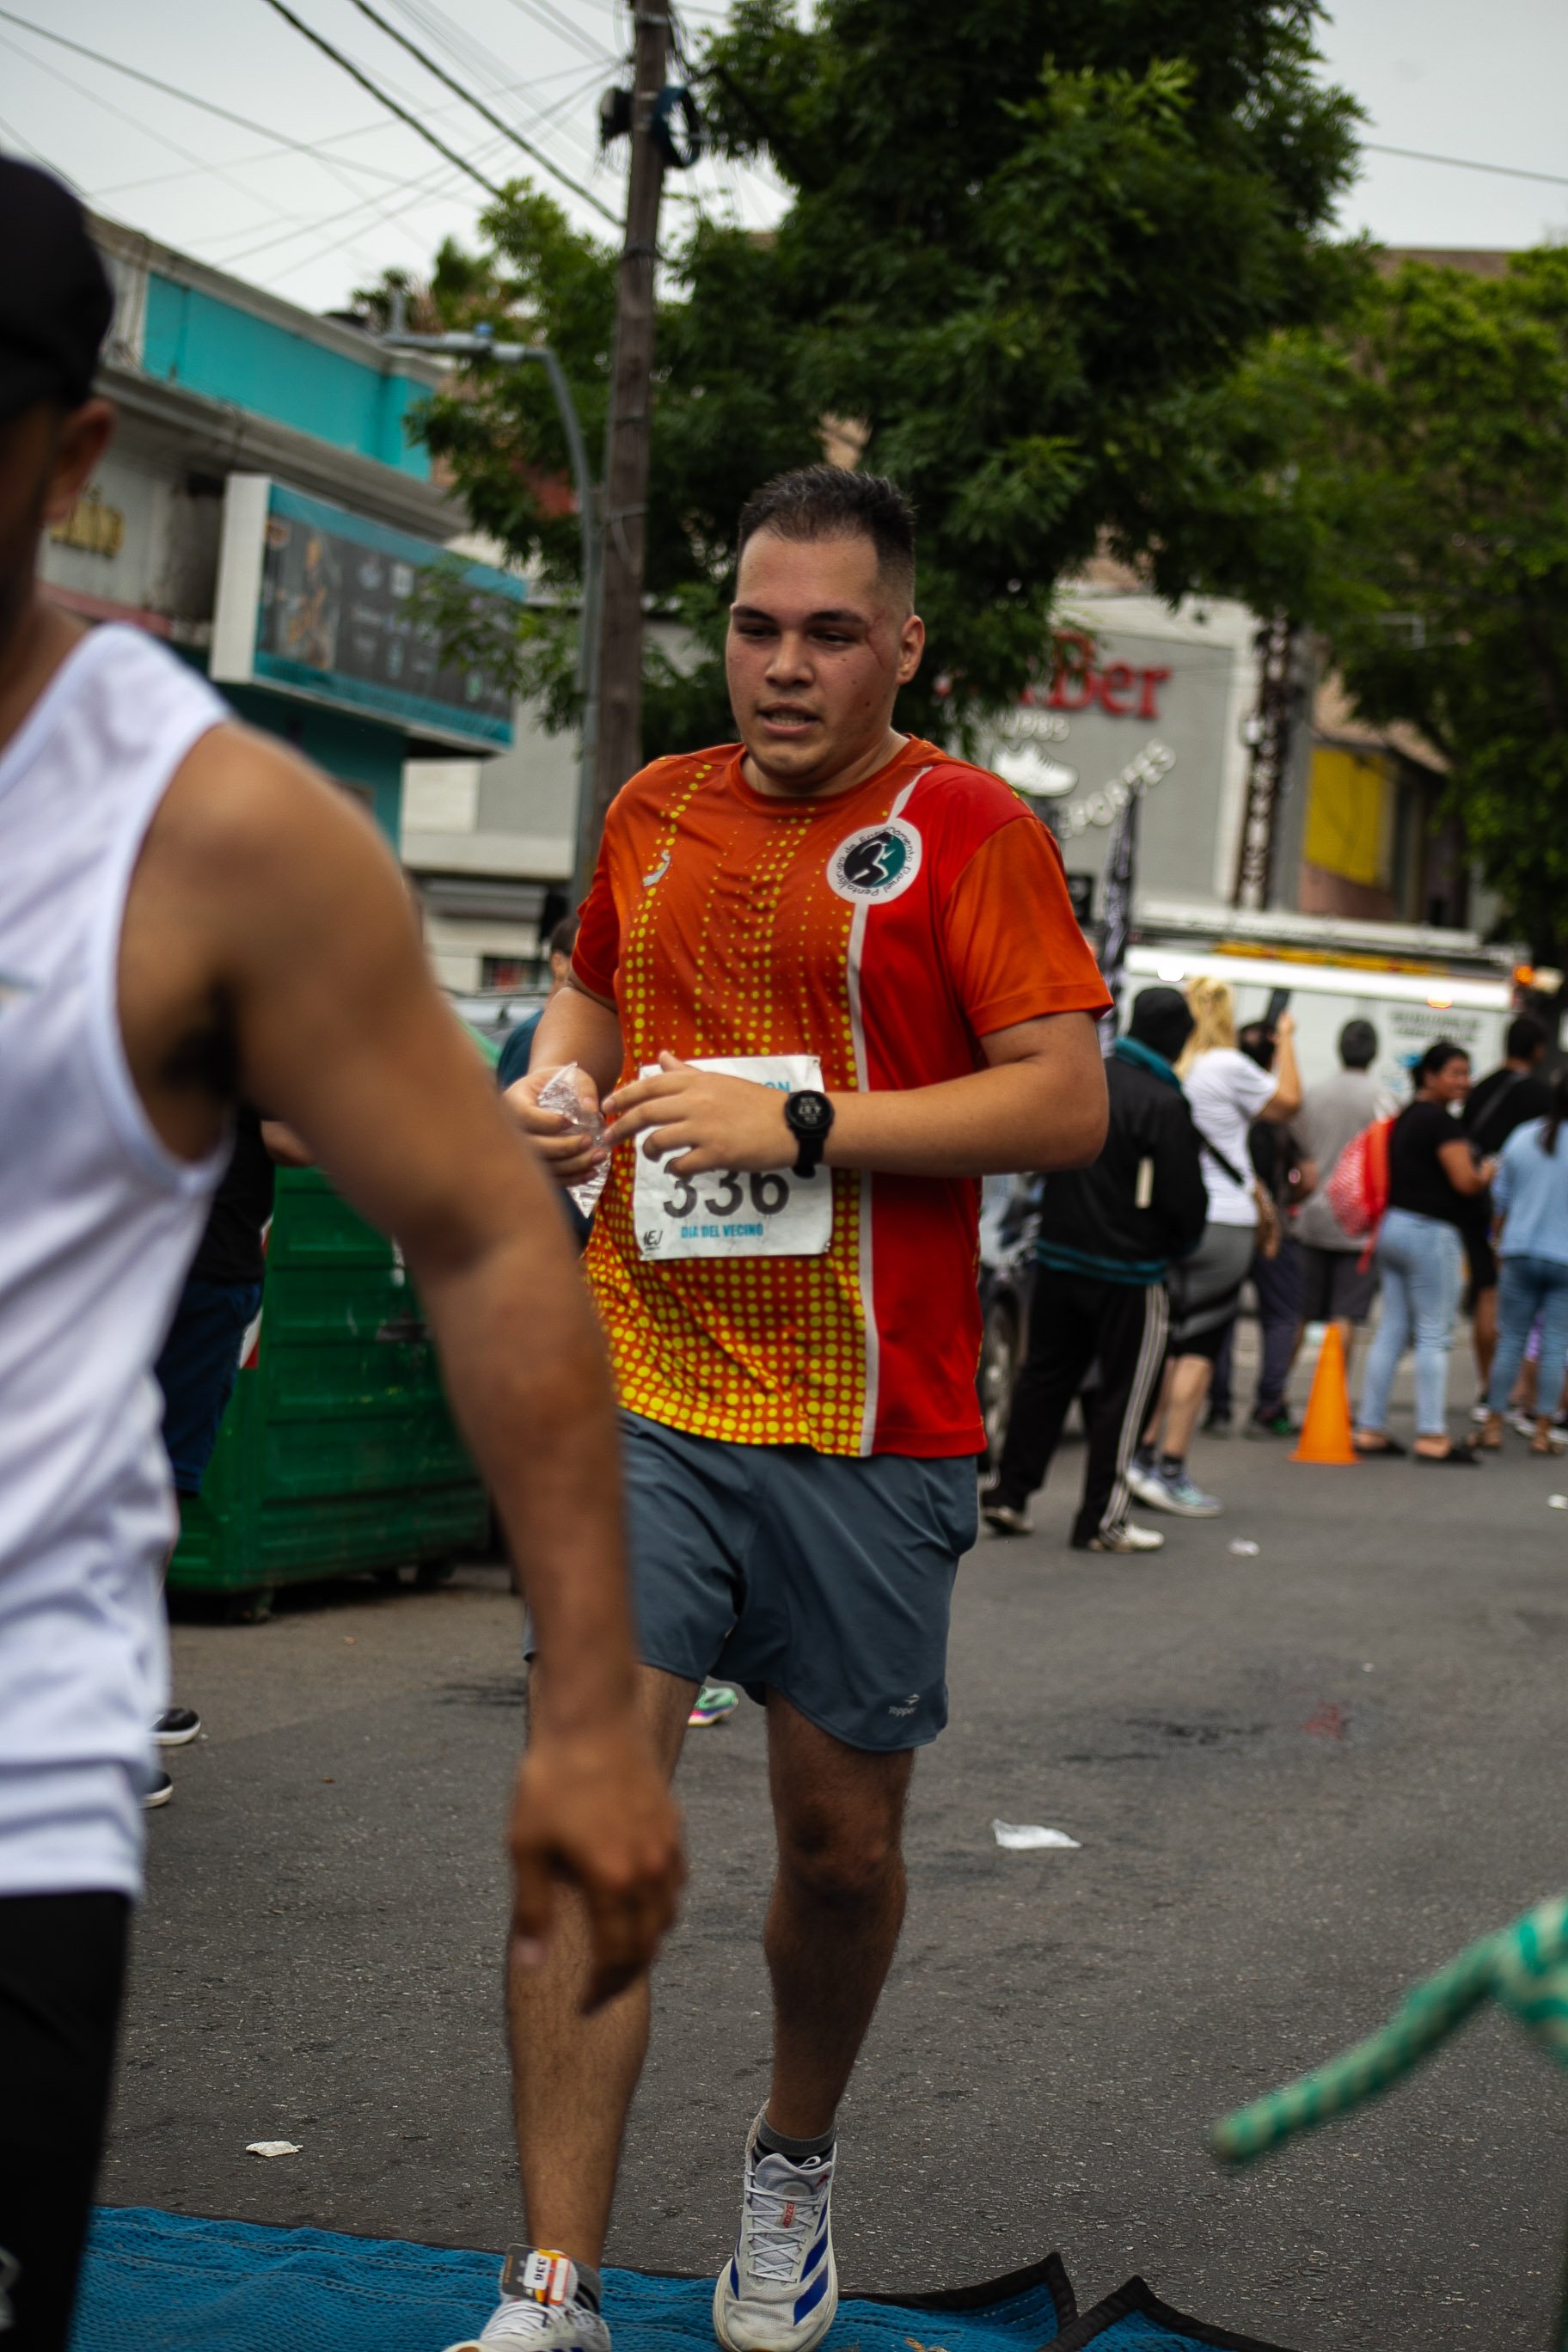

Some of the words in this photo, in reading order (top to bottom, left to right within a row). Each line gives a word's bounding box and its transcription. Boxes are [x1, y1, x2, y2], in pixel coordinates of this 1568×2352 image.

[663, 1158, 790, 1219] 336
[681, 1226, 698, 1239] DIA
[701, 1225, 720, 1238] DEL
[723, 1223, 763, 1237] VECINO
